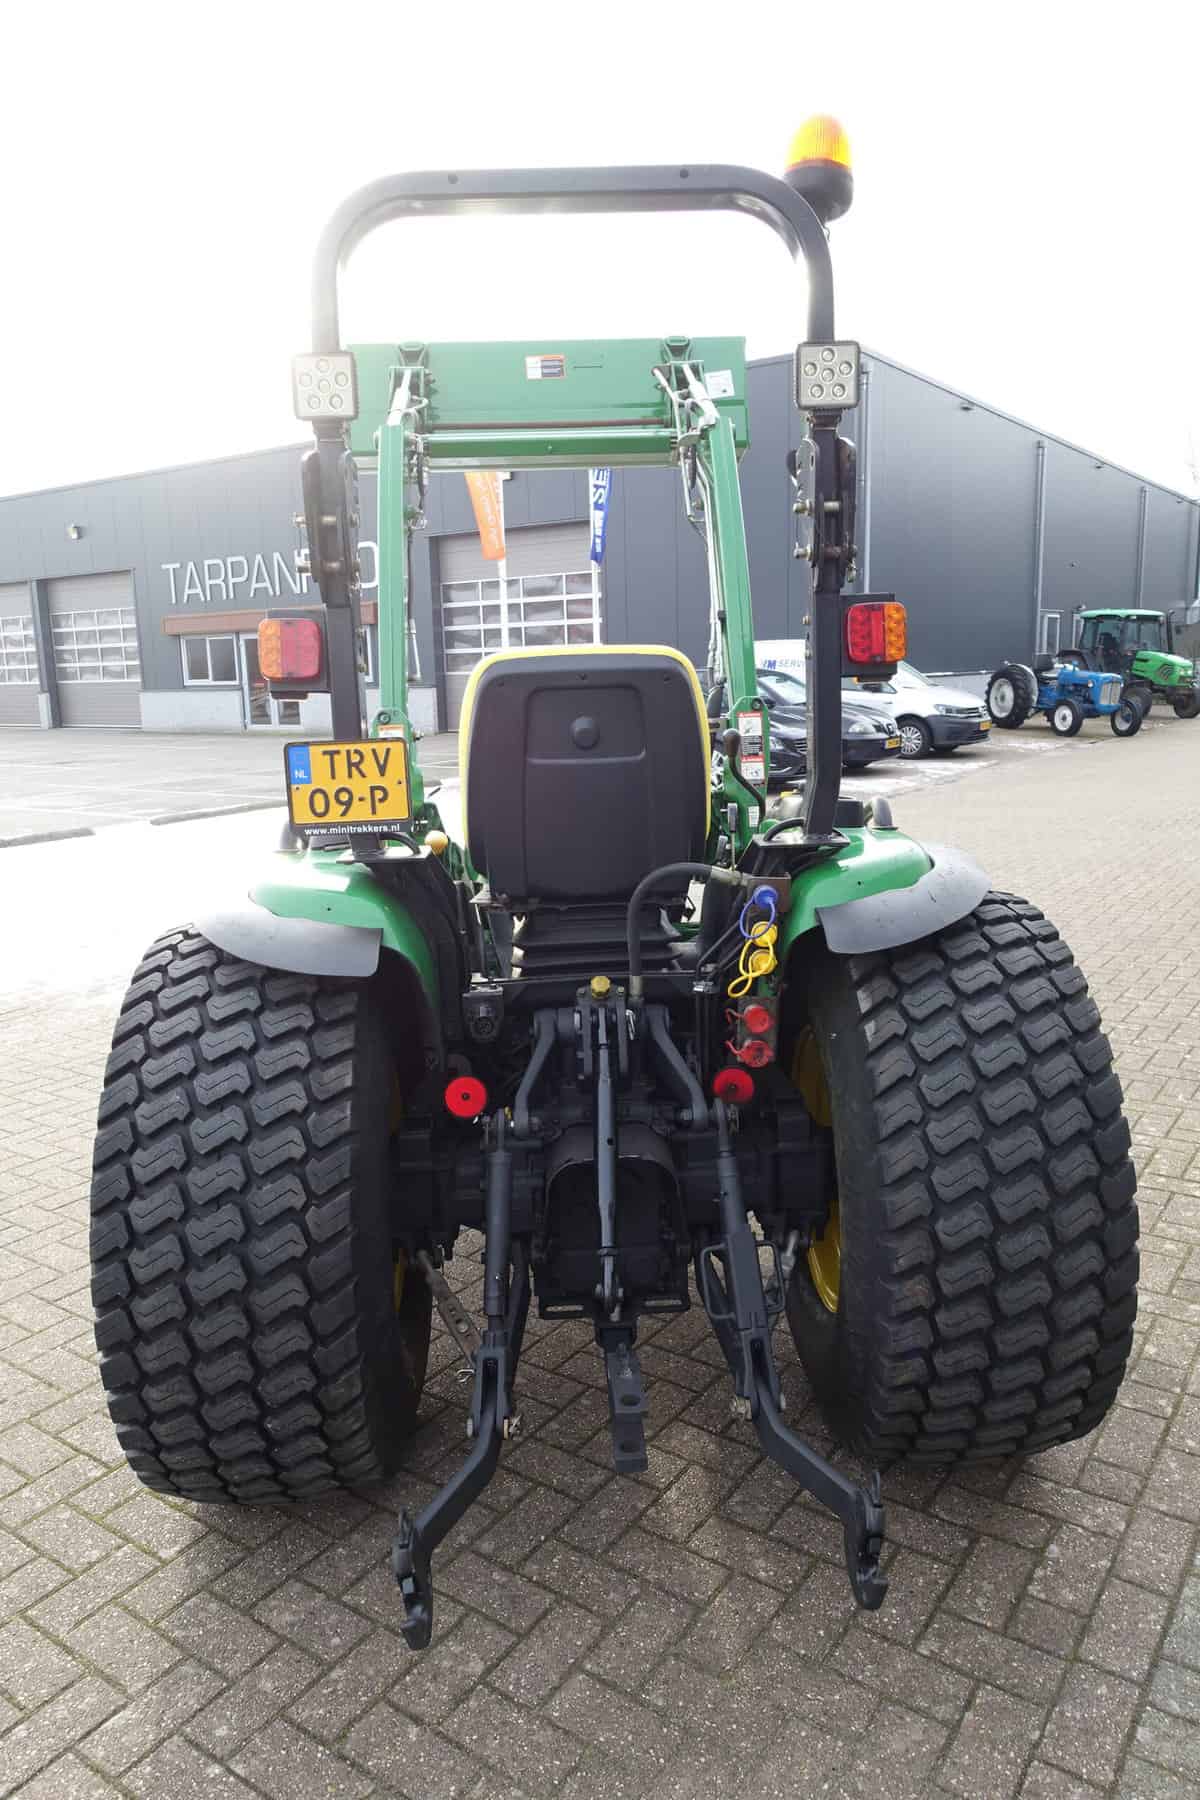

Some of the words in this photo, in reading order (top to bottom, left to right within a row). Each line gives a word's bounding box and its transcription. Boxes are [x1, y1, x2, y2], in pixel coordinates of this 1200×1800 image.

[295, 769, 308, 779] NL
[322, 748, 391, 780] TRV
[309, 785, 389, 818] 09-P
[304, 823, 400, 835] www.minitrekkers.nl
